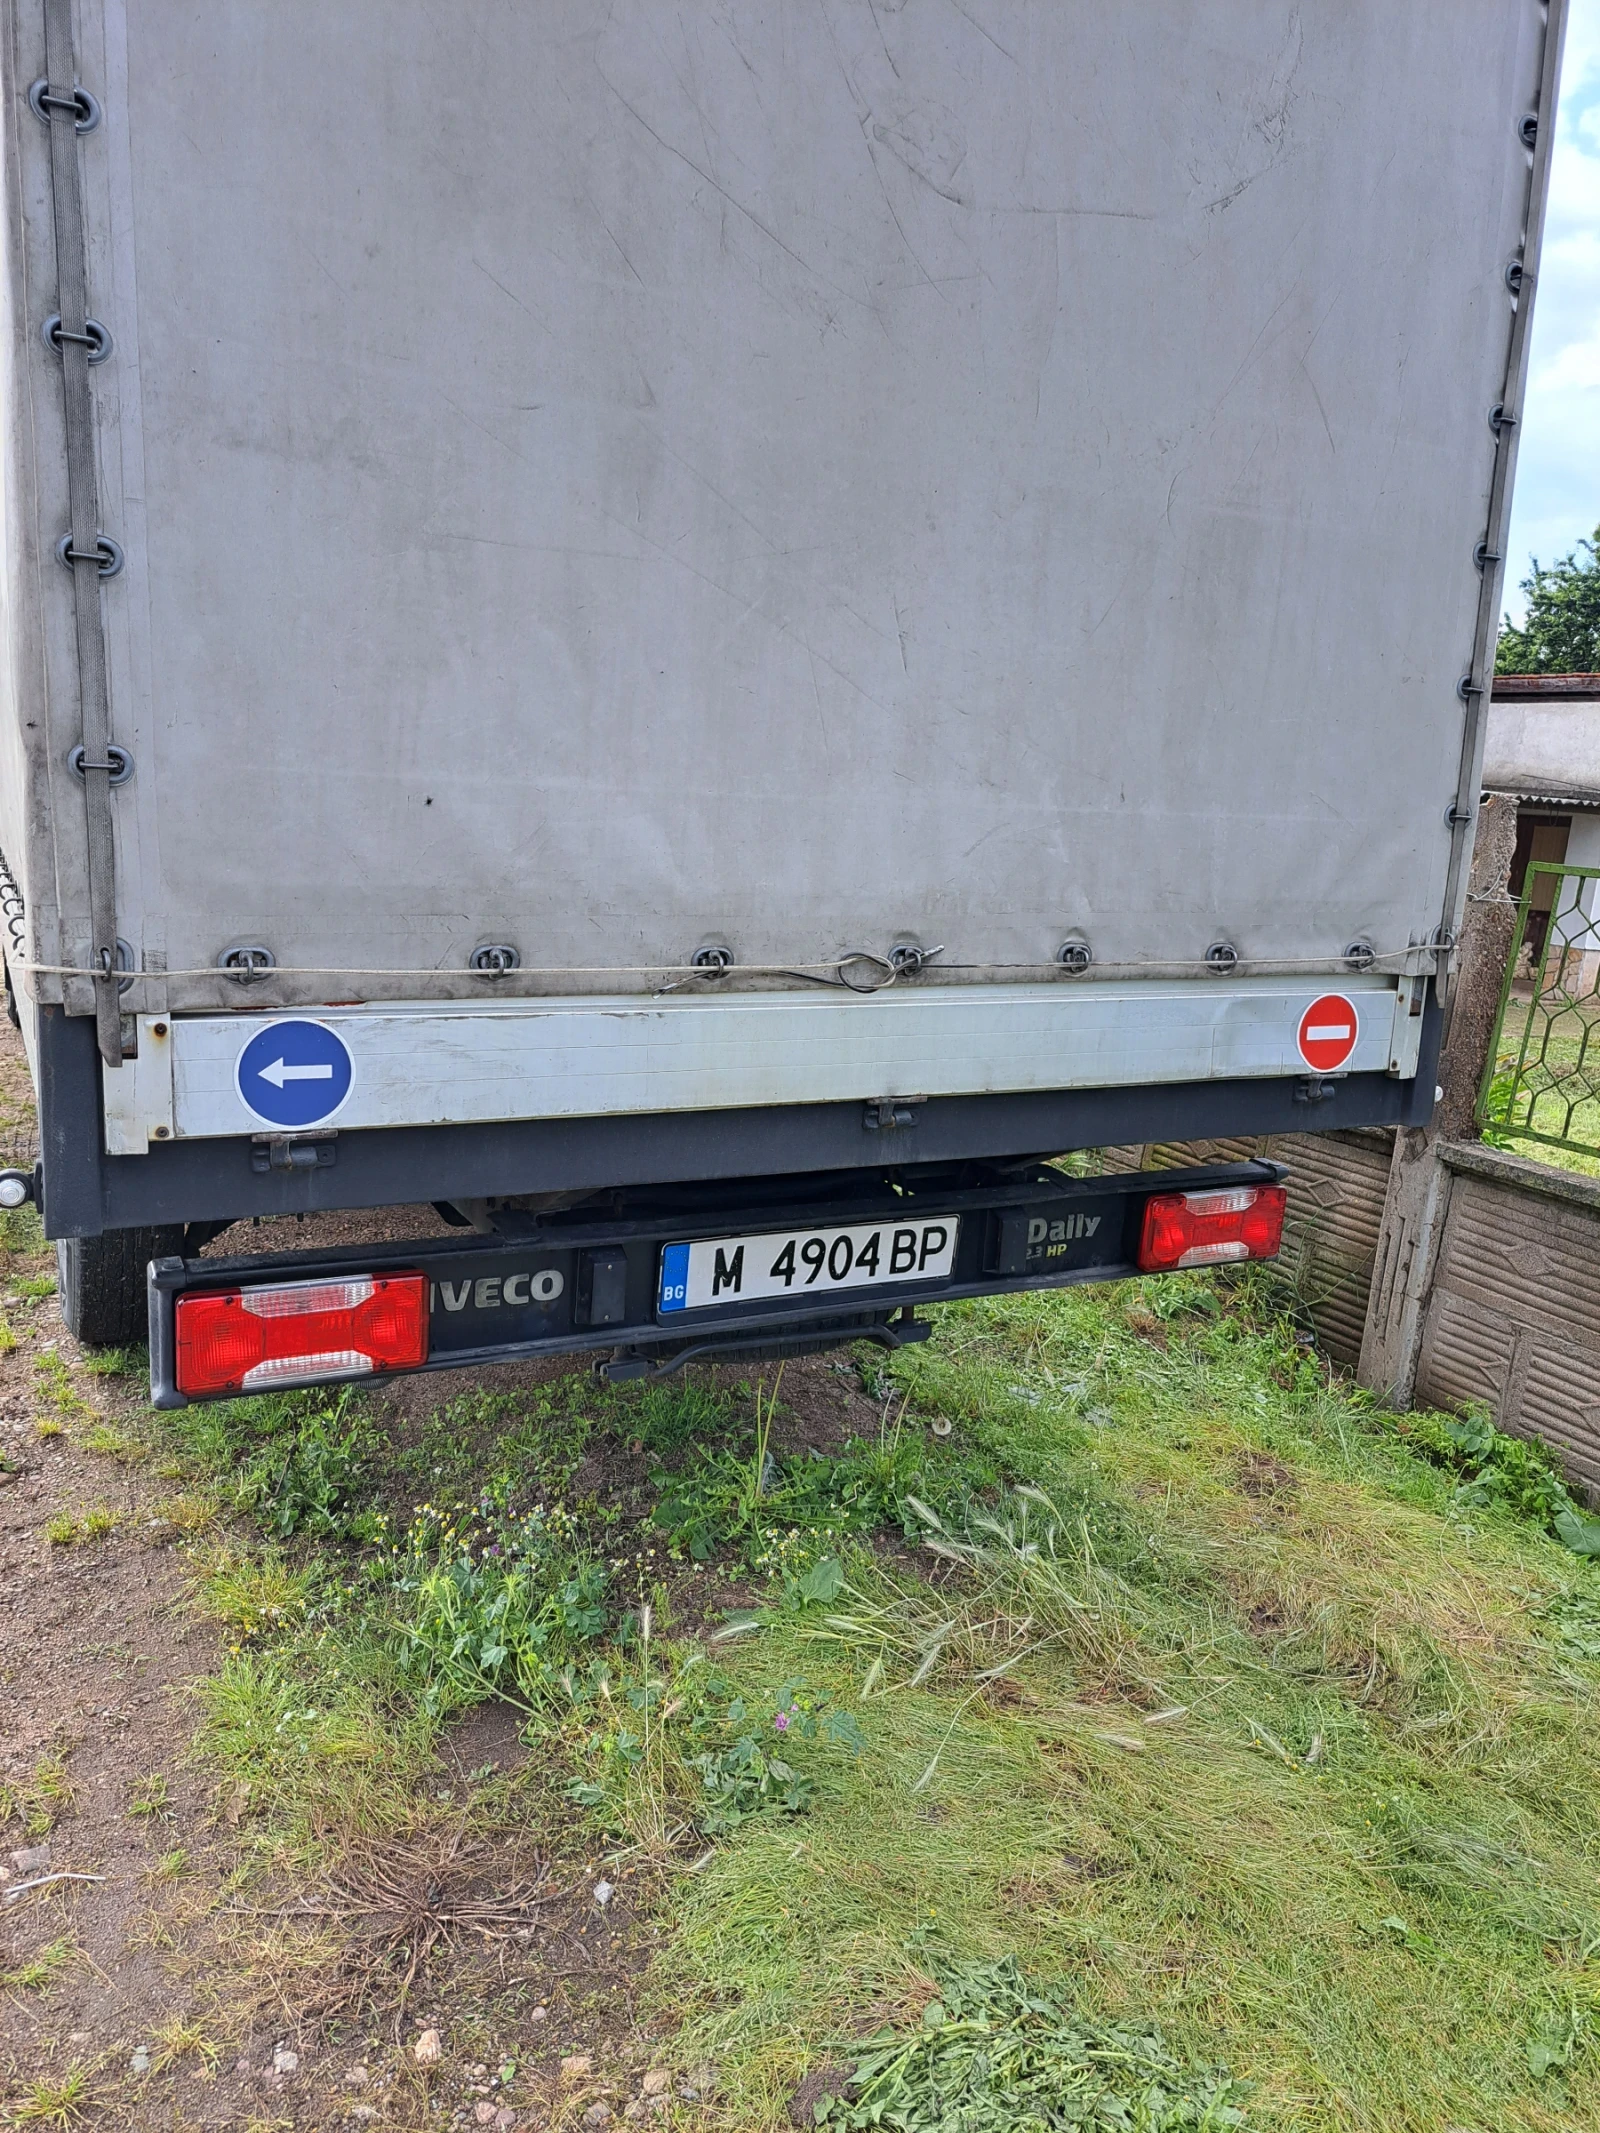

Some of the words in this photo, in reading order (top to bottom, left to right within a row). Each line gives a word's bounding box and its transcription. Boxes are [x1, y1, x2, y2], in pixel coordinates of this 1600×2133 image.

[1027, 1213, 1101, 1244] Daily
[711, 1244, 745, 1296] M
[769, 1231, 881, 1287] 4904
[888, 1225, 948, 1275] BP
[1046, 1243, 1068, 1258] HP
[663, 1284, 685, 1301] BG
